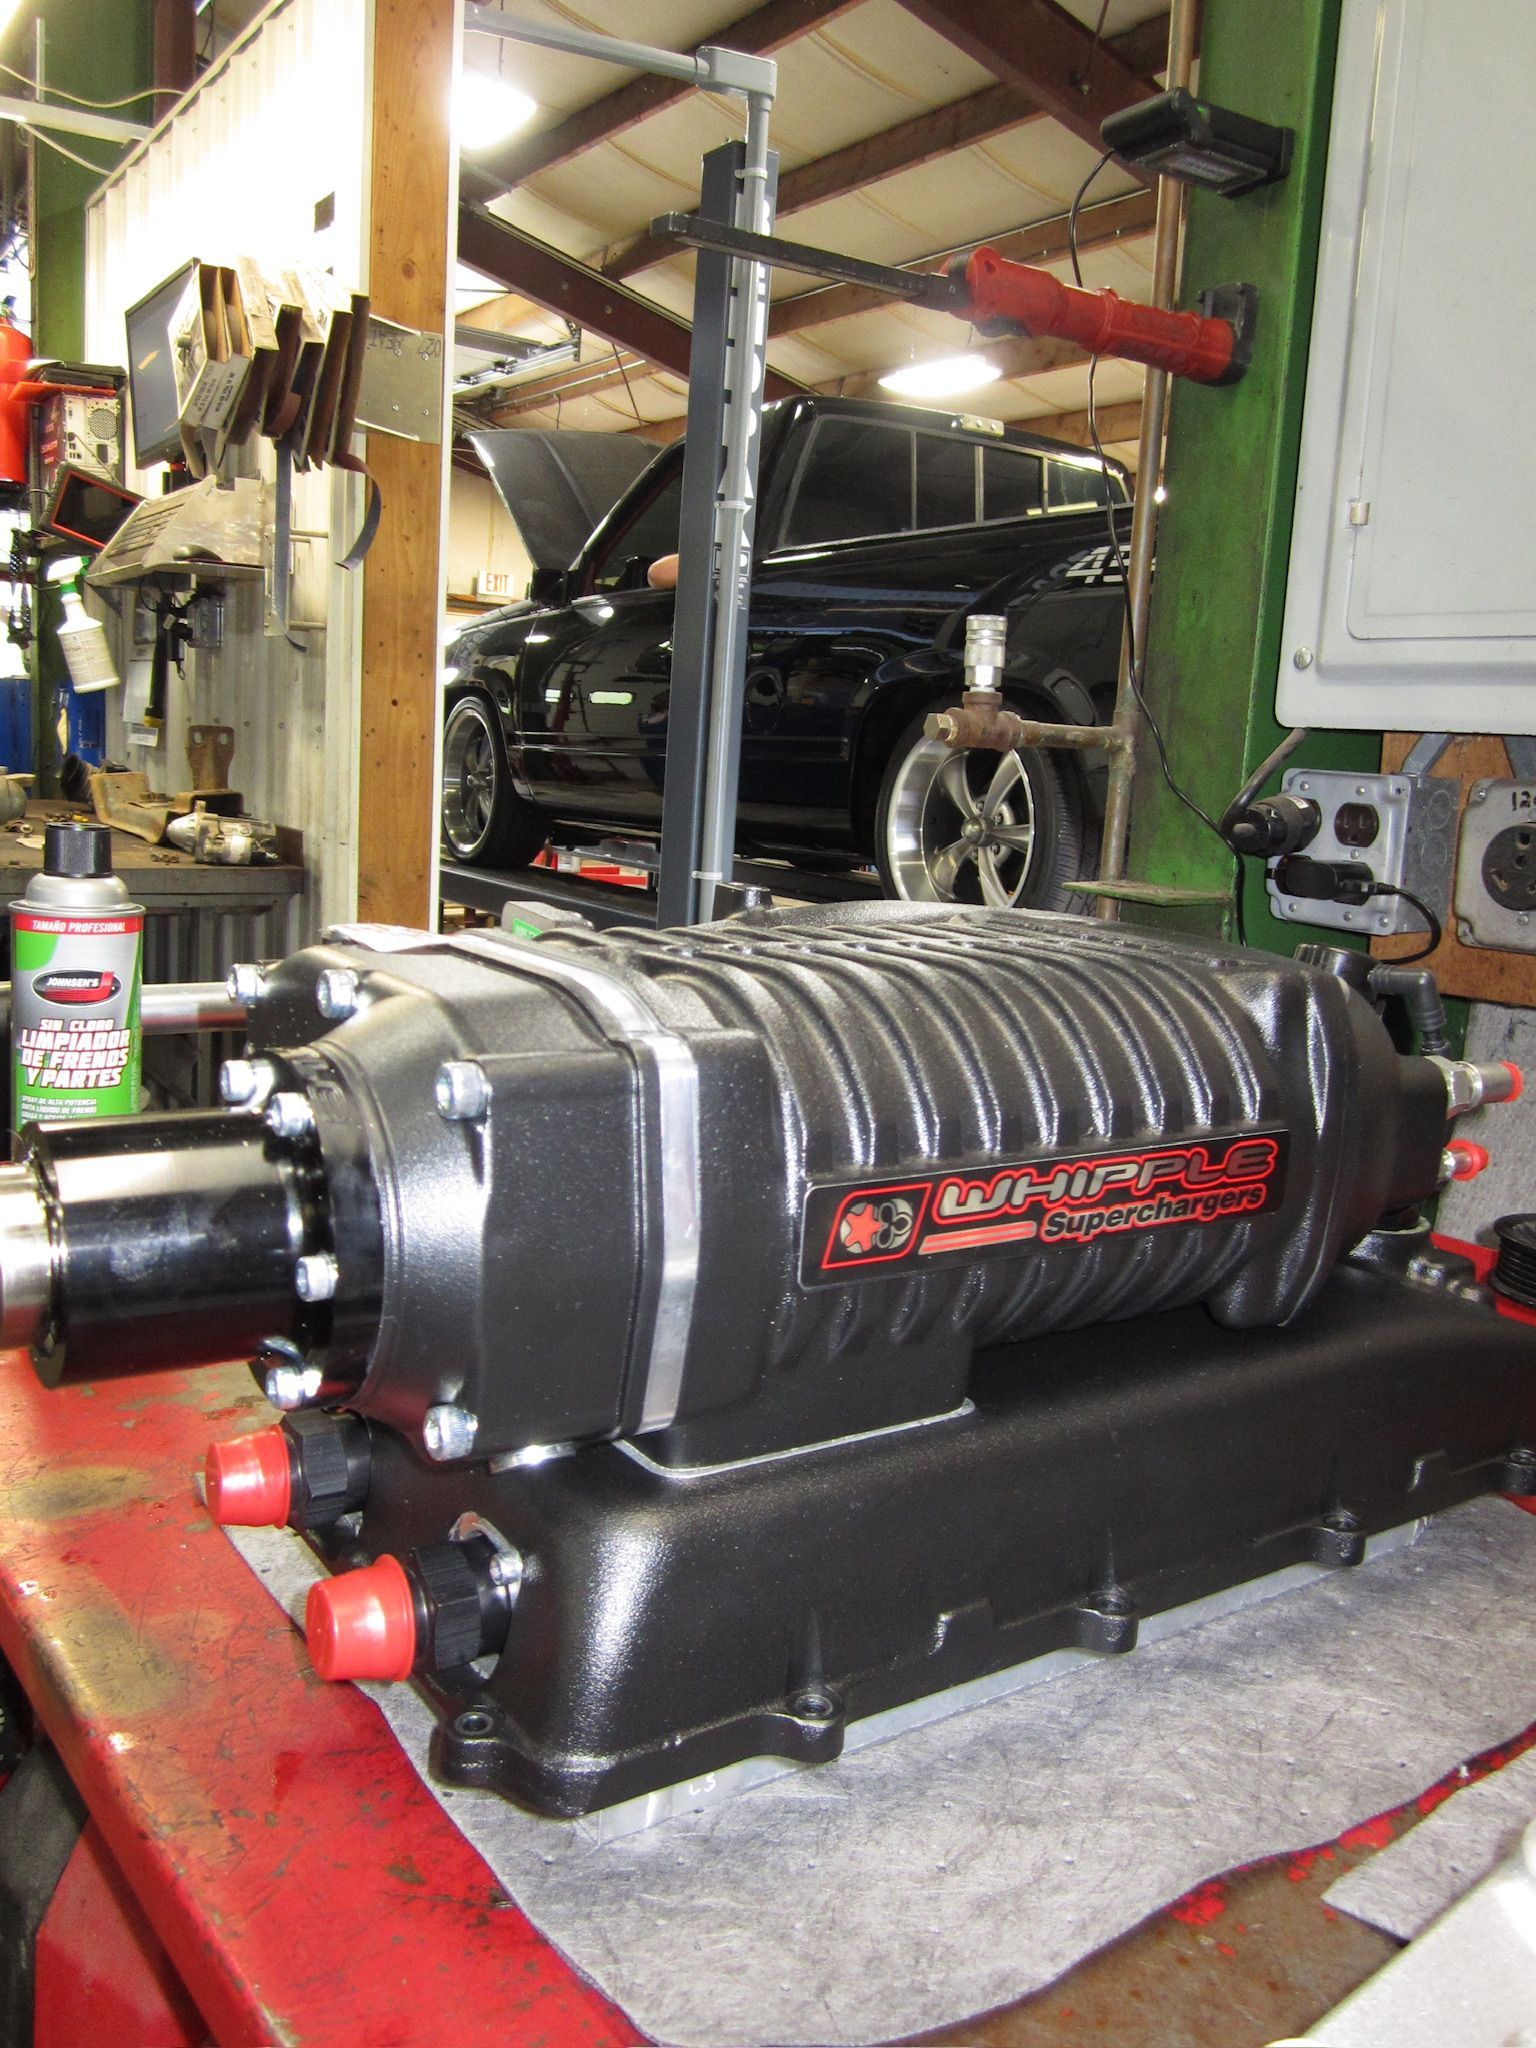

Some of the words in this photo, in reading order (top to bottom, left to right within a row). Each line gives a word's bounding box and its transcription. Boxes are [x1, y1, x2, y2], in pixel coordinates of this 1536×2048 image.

[486, 573, 509, 593] EXIT
[32, 920, 66, 932] TAMAÑO
[68, 921, 126, 933] PROFESIONAL
[46, 977, 100, 988] JOHNSEN'S
[40, 1019, 63, 1031] SIN
[69, 1019, 114, 1031] CLORO
[21, 1028, 131, 1050] LIMPIADOR
[21, 1048, 45, 1067] DE
[48, 1048, 130, 1069] FRENOS
[27, 1067, 41, 1086] Y
[40, 1067, 122, 1088] PARTES
[936, 1140, 1275, 1221] WHIPPLE
[1042, 1185, 1264, 1240] Superchargers
